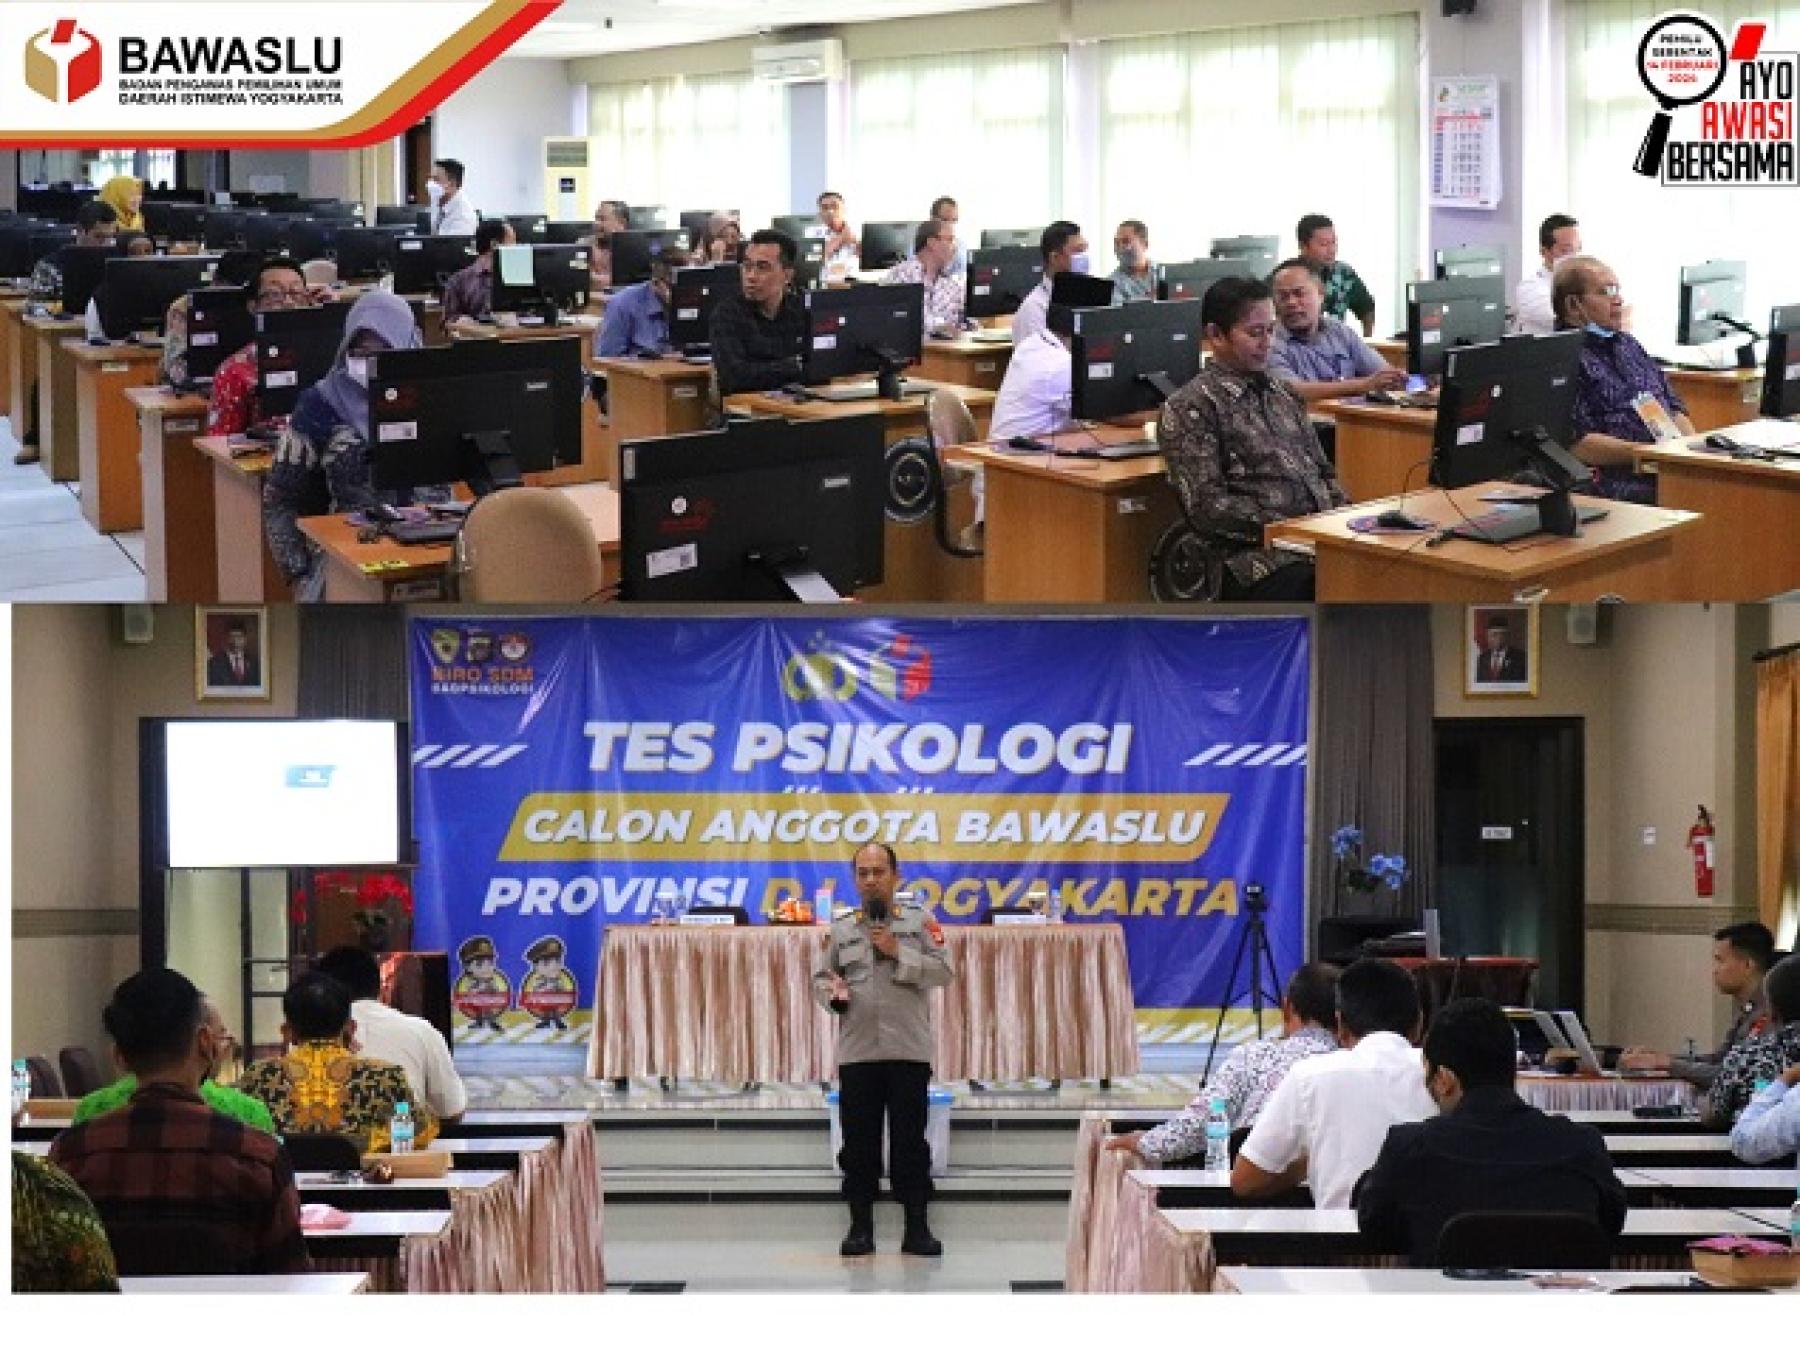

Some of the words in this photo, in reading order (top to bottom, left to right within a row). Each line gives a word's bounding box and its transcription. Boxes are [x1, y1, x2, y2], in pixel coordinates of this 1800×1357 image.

[584, 721, 716, 773] TES
[732, 721, 1134, 775] PSIKOLOGI
[522, 809, 694, 844] CALON
[699, 809, 941, 845] ANGGOTA
[953, 809, 1208, 844] BAWASLU
[481, 876, 751, 916] PROVINSI
